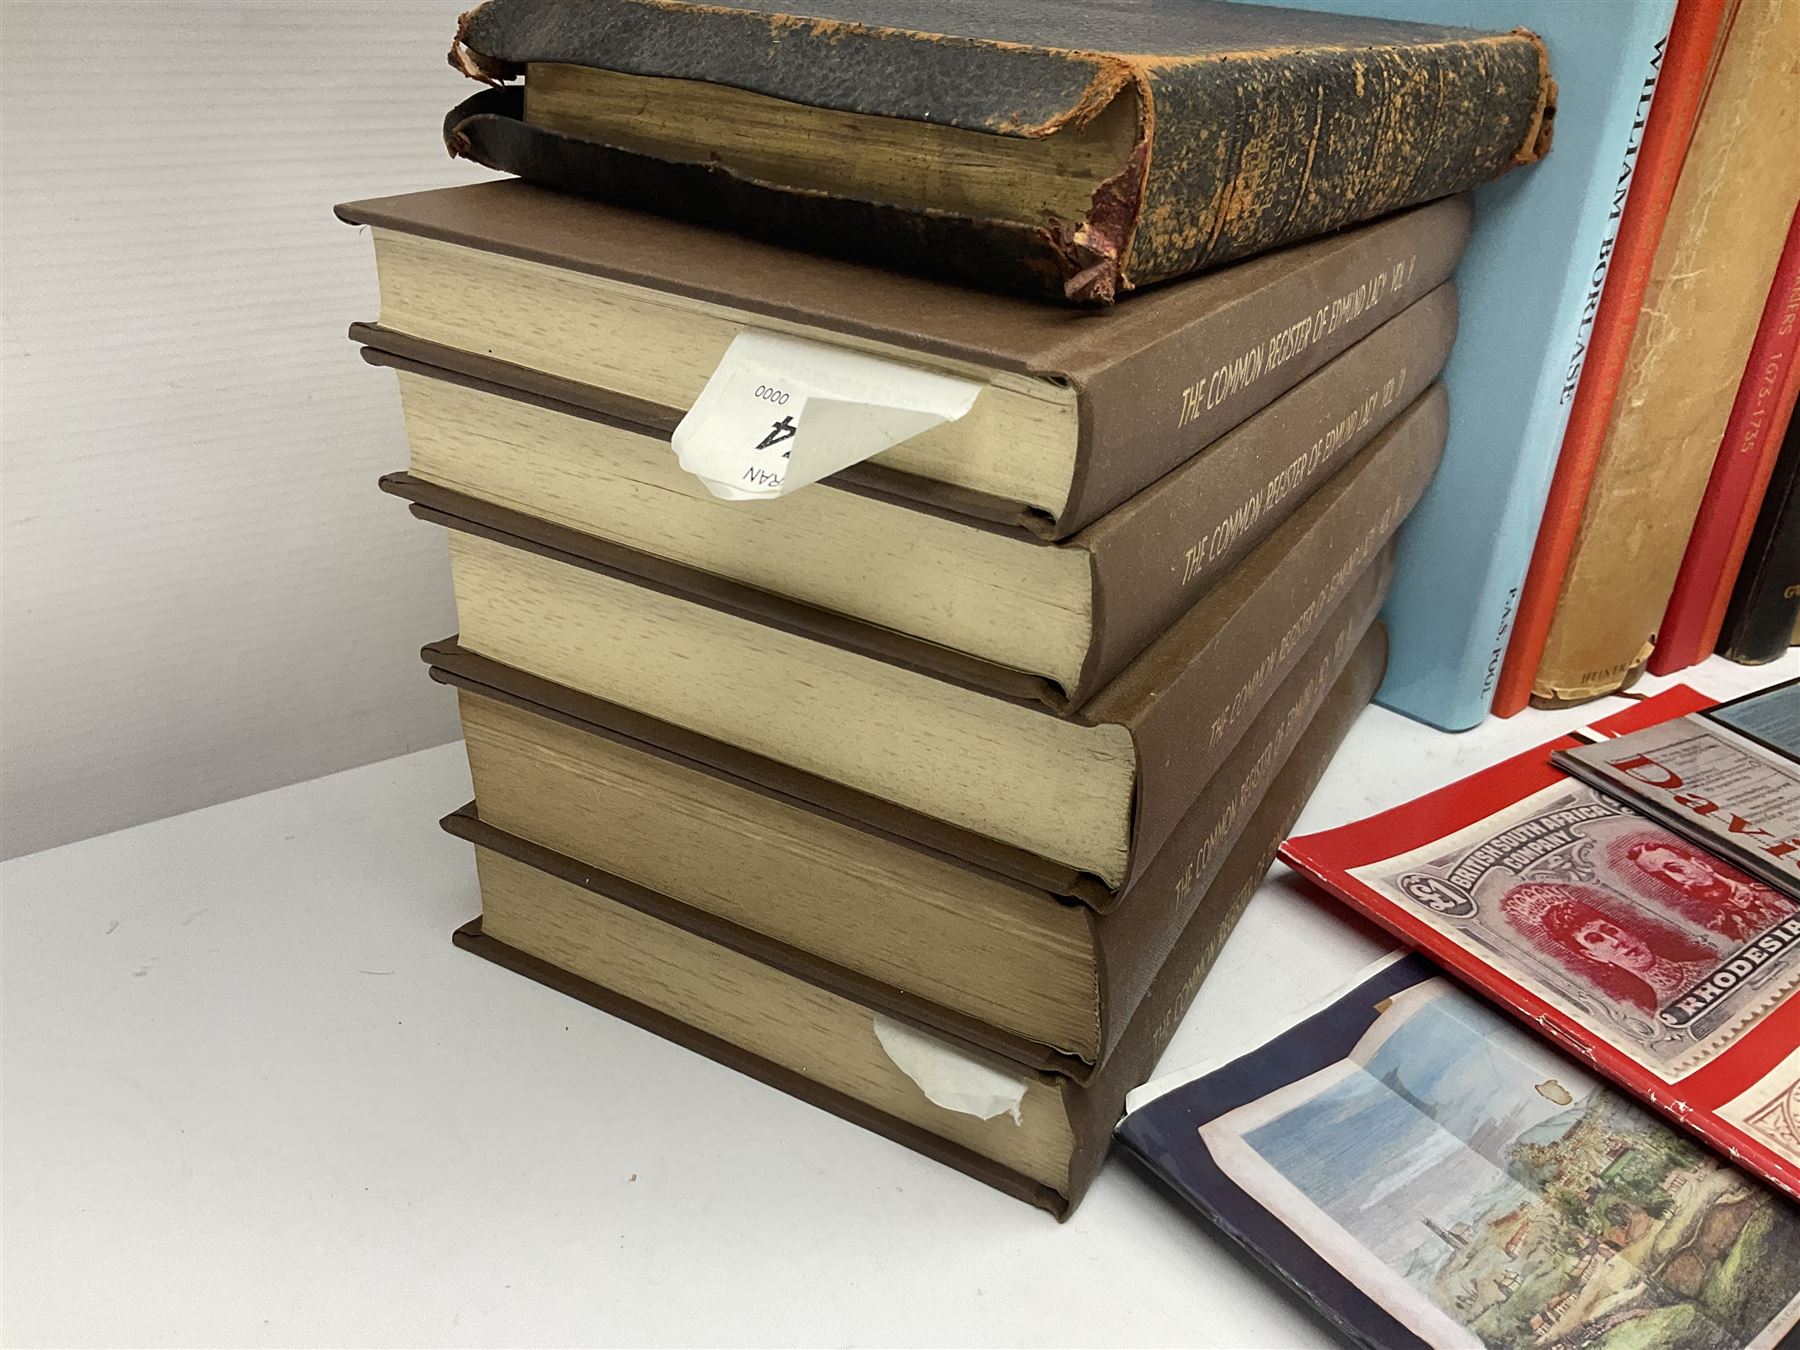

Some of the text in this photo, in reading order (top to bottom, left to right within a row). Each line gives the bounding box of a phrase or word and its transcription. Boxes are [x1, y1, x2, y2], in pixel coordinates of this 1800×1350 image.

[1559, 36, 1668, 405] WILLIAM BORLASE
[754, 385, 790, 405] 0000
[1178, 378, 1206, 429] THE
[1206, 343, 1264, 411] COMMON
[1264, 316, 1312, 374] REGISTER
[1312, 305, 1329, 344] OF
[1328, 285, 1366, 335] EDMUND
[1365, 272, 1387, 311] LACY
[755, 415, 797, 459] 4
[1741, 352, 1783, 453] 1675-1735
[1182, 535, 1208, 585] THE
[1209, 489, 1263, 562] COMMON
[1262, 452, 1308, 515] REGISTER
[1307, 438, 1323, 476] OF
[1321, 410, 1358, 464] EDMUND
[1356, 391, 1378, 432] LACY
[1208, 704, 1231, 754] THE
[1230, 648, 1278, 724] COMMON
[1174, 863, 1193, 912] THE
[1196, 793, 1238, 879] COMMON
[1450, 803, 1613, 889] BRITISH SOUTH AFRICA
[1504, 829, 1573, 871] COMPANY
[1411, 877, 1468, 912] £1
[1152, 1008, 1172, 1060] THE
